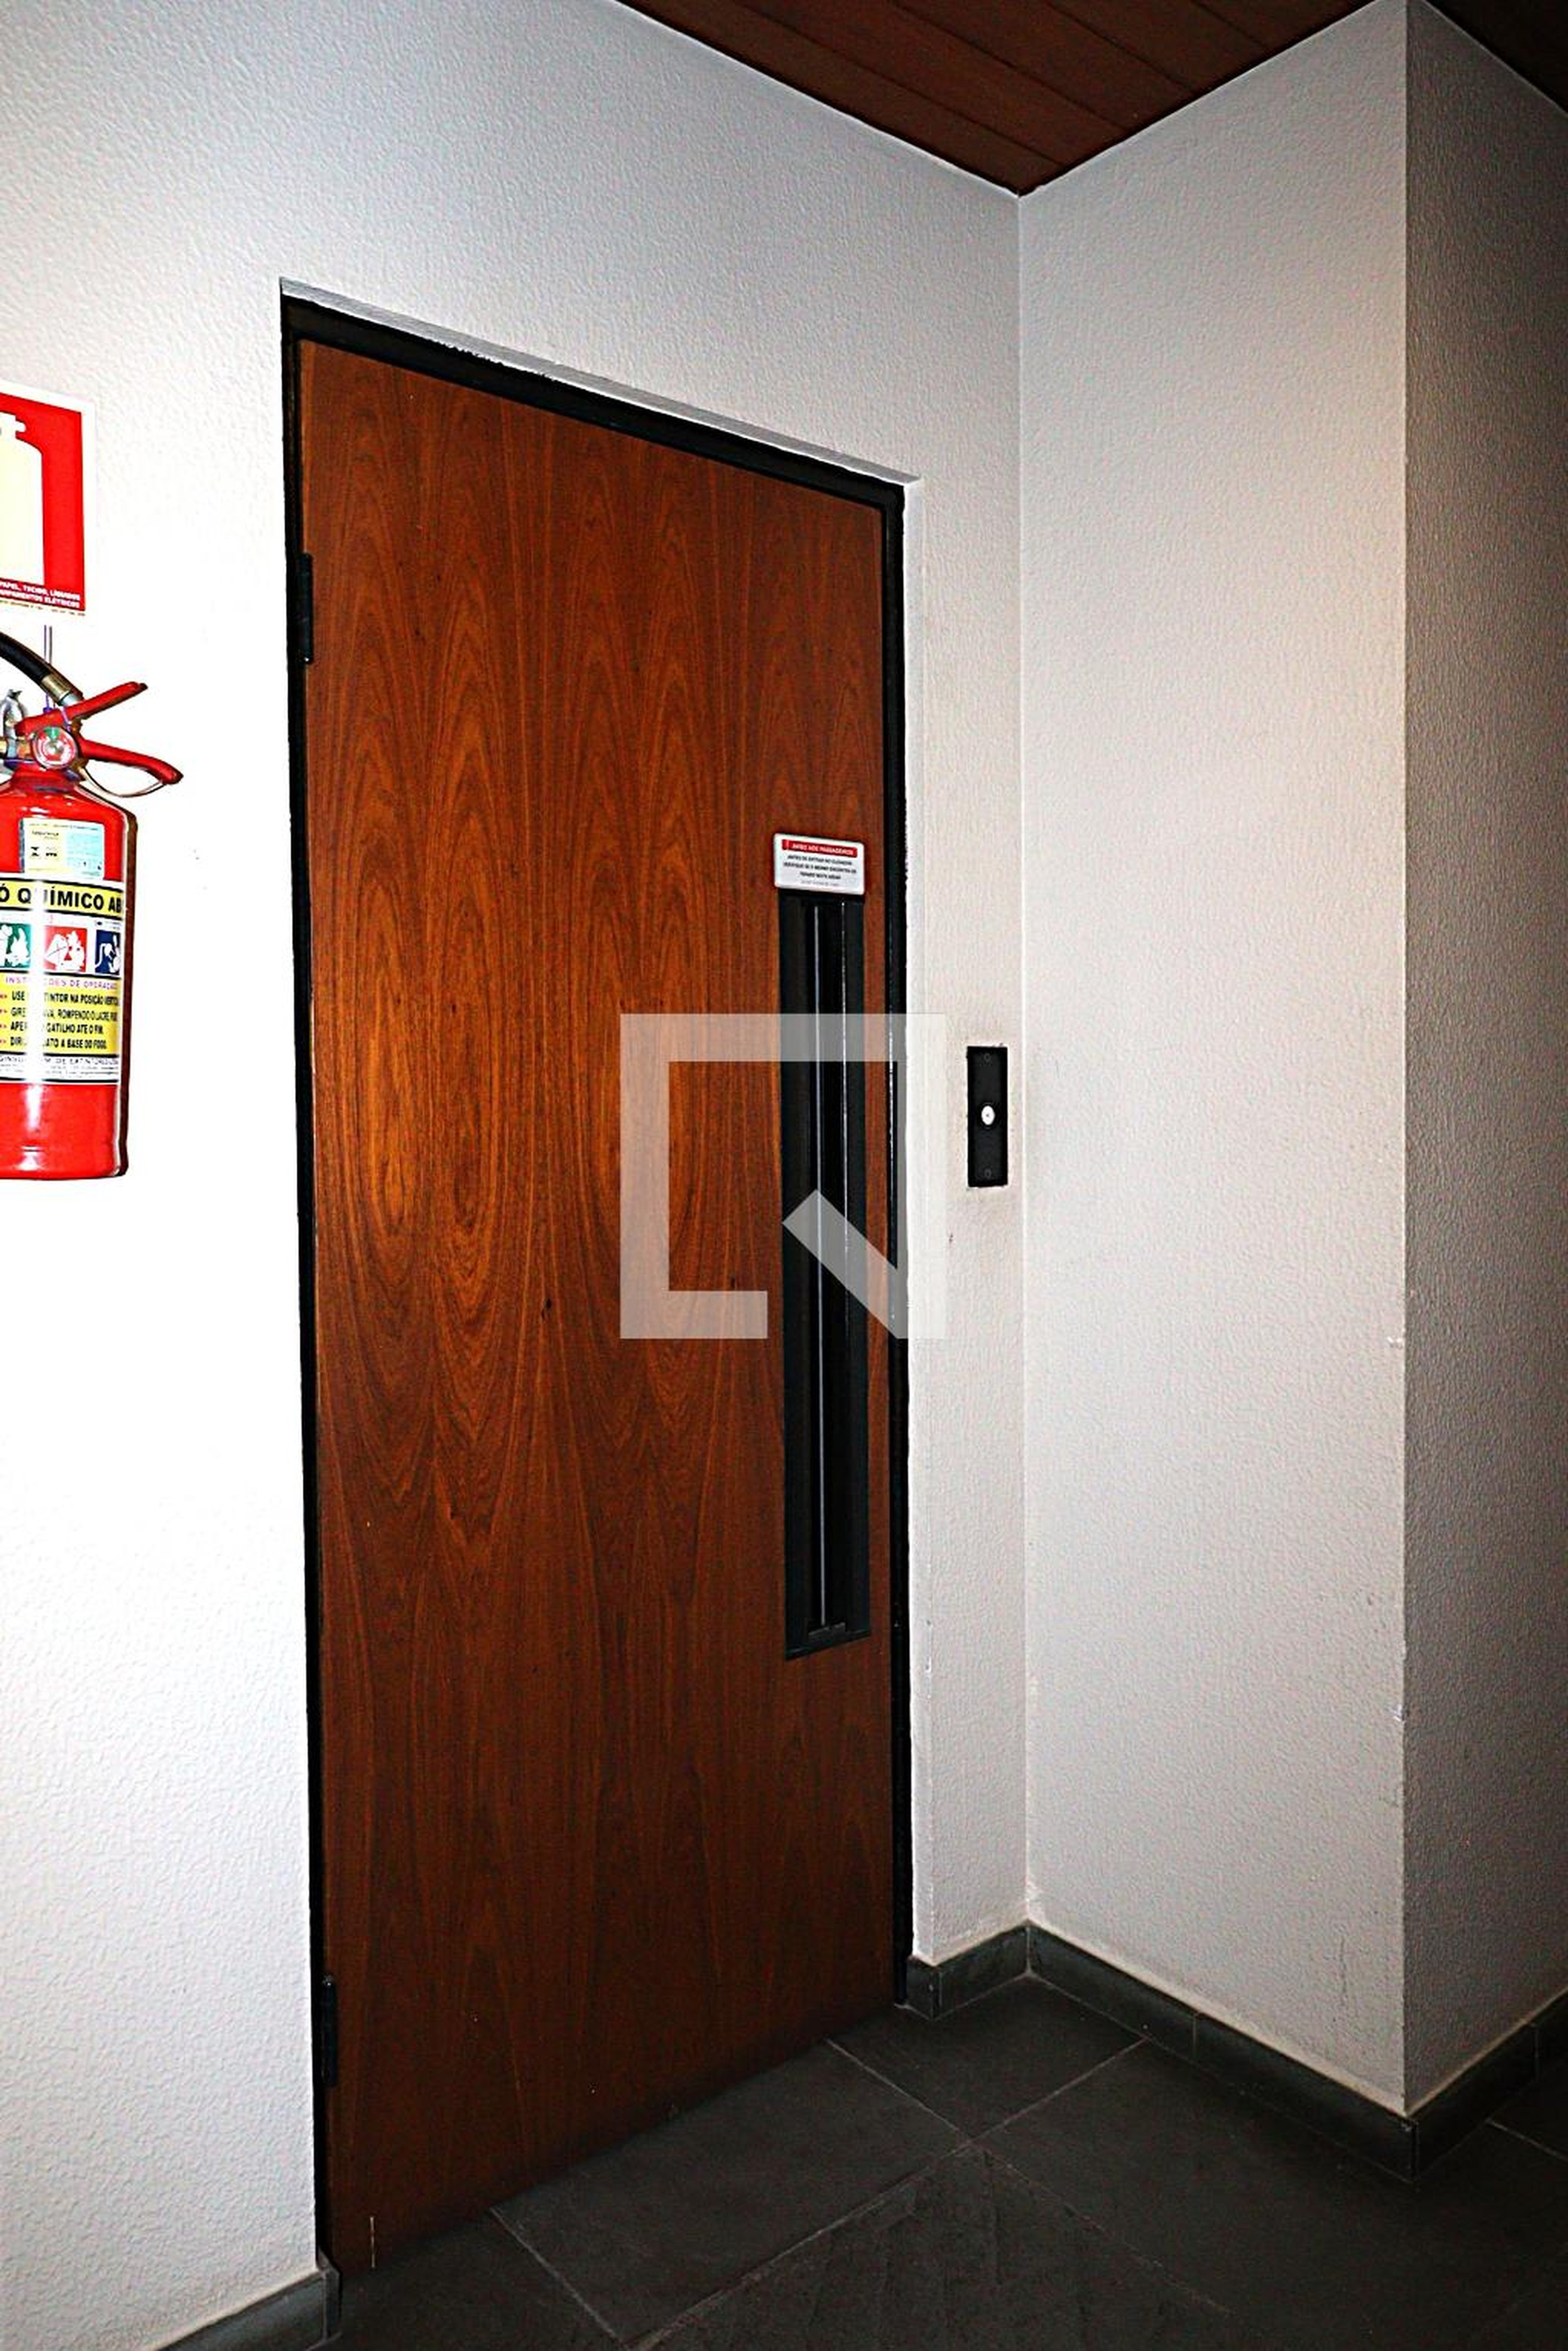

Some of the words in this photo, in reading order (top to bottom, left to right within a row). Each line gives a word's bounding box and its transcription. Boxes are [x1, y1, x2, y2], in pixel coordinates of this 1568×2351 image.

[12, 990, 25, 1001] USE
[70, 993, 79, 1004] NA
[80, 994, 103, 1005] POSIÇÃO
[46, 1022, 76, 1033] GATILHO
[67, 1038, 83, 1048] BASE
